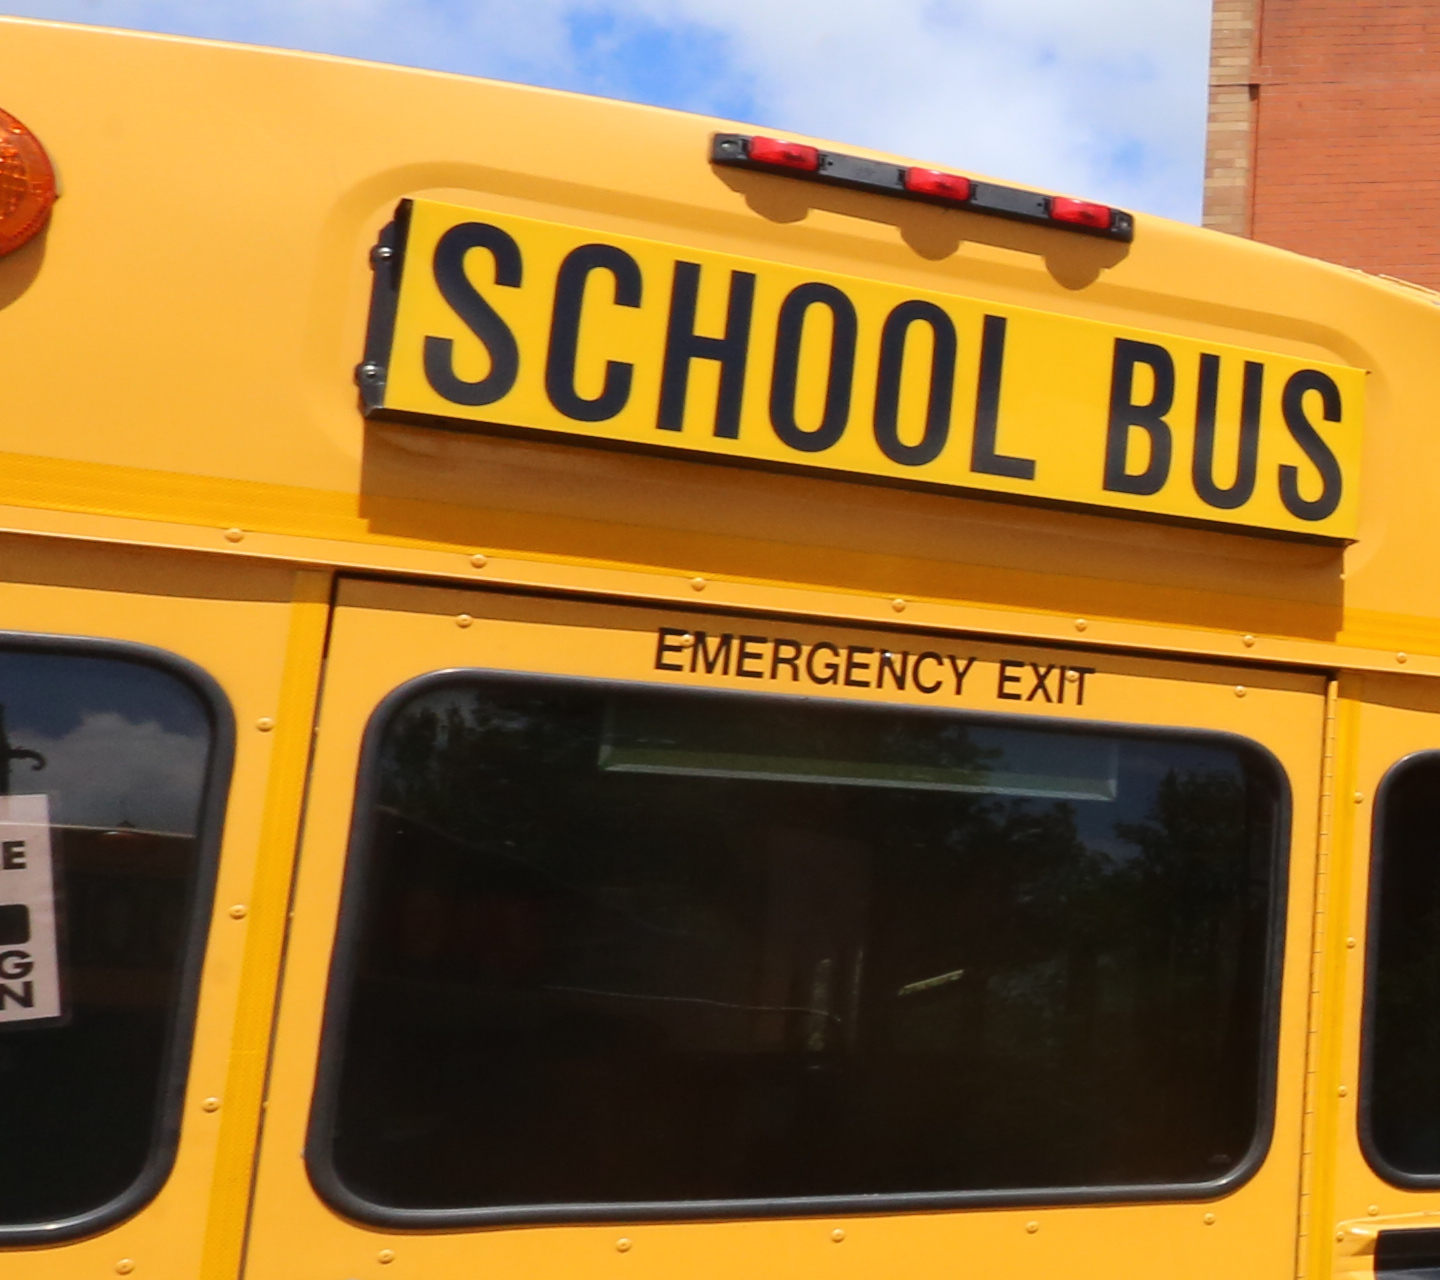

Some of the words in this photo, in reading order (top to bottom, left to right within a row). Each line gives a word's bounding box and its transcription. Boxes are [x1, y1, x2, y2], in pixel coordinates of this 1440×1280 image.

[422, 221, 1035, 481] SCHOOL
[1101, 337, 1344, 521] BUS
[654, 626, 977, 696] EMERGENCY
[997, 659, 1096, 705] EXIT
